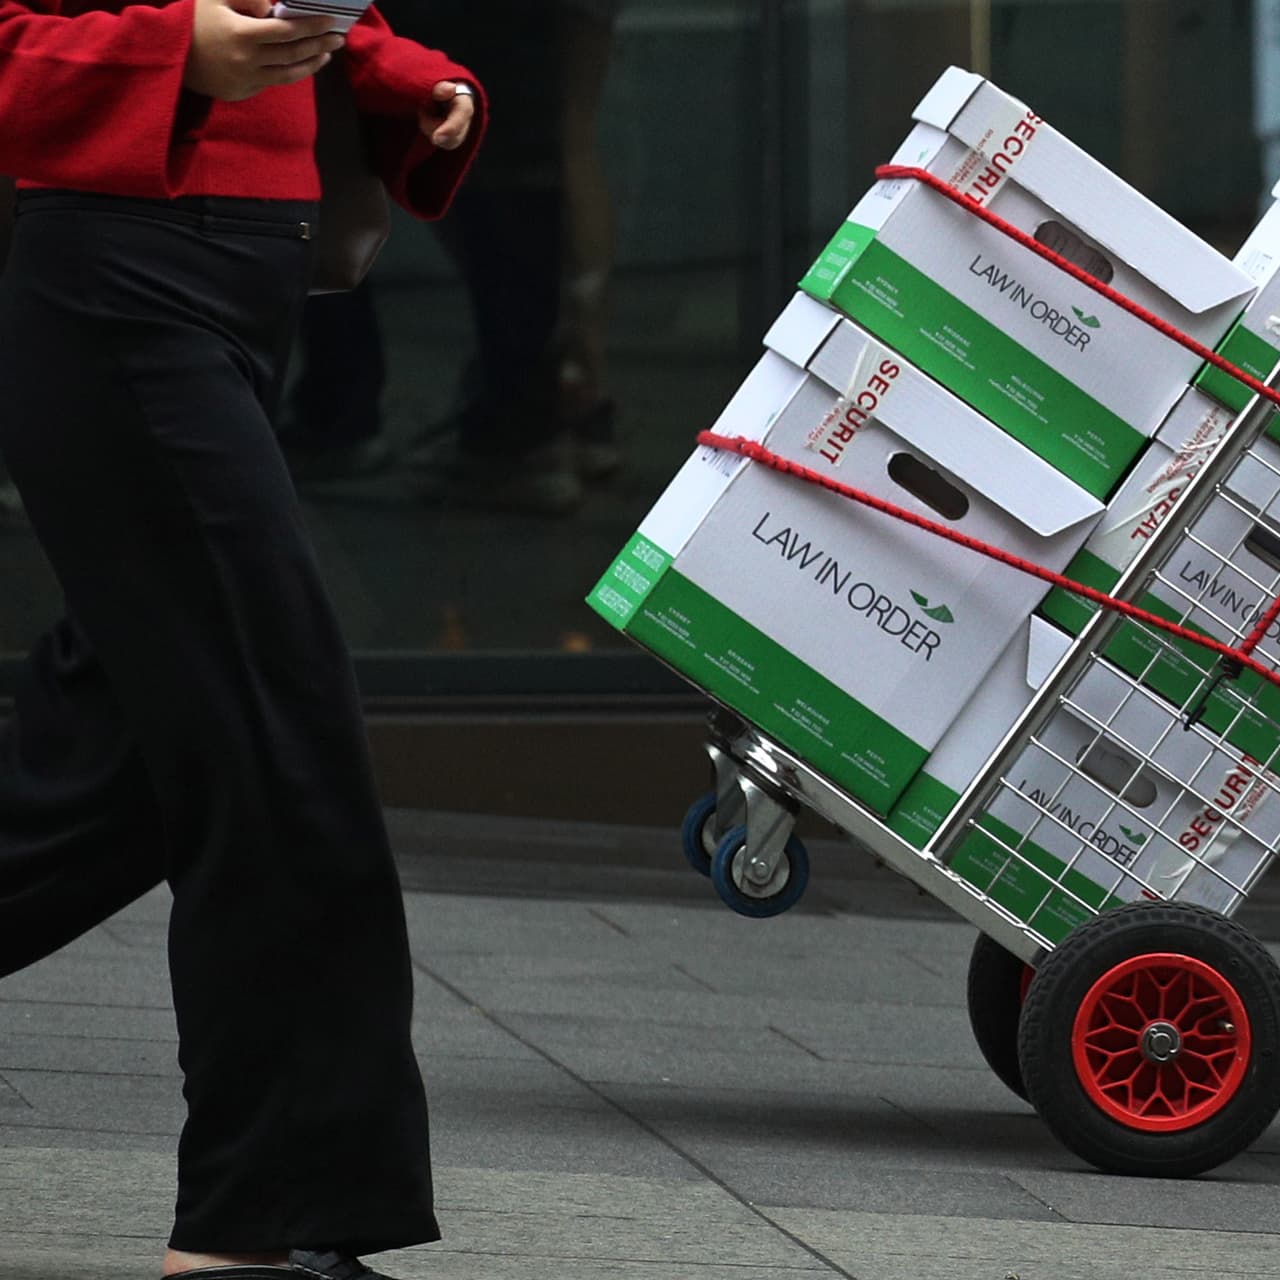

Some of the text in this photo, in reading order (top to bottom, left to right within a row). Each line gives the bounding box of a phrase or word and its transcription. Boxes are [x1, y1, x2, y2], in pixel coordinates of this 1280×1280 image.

[969, 254, 1091, 353] LAW IN ORDER
[820, 360, 900, 464] SECURIT
[752, 512, 942, 662] LAW IN ORDER
[1179, 560, 1227, 598] LAW
[1220, 587, 1245, 614] IN
[1057, 806, 1081, 829] IN
